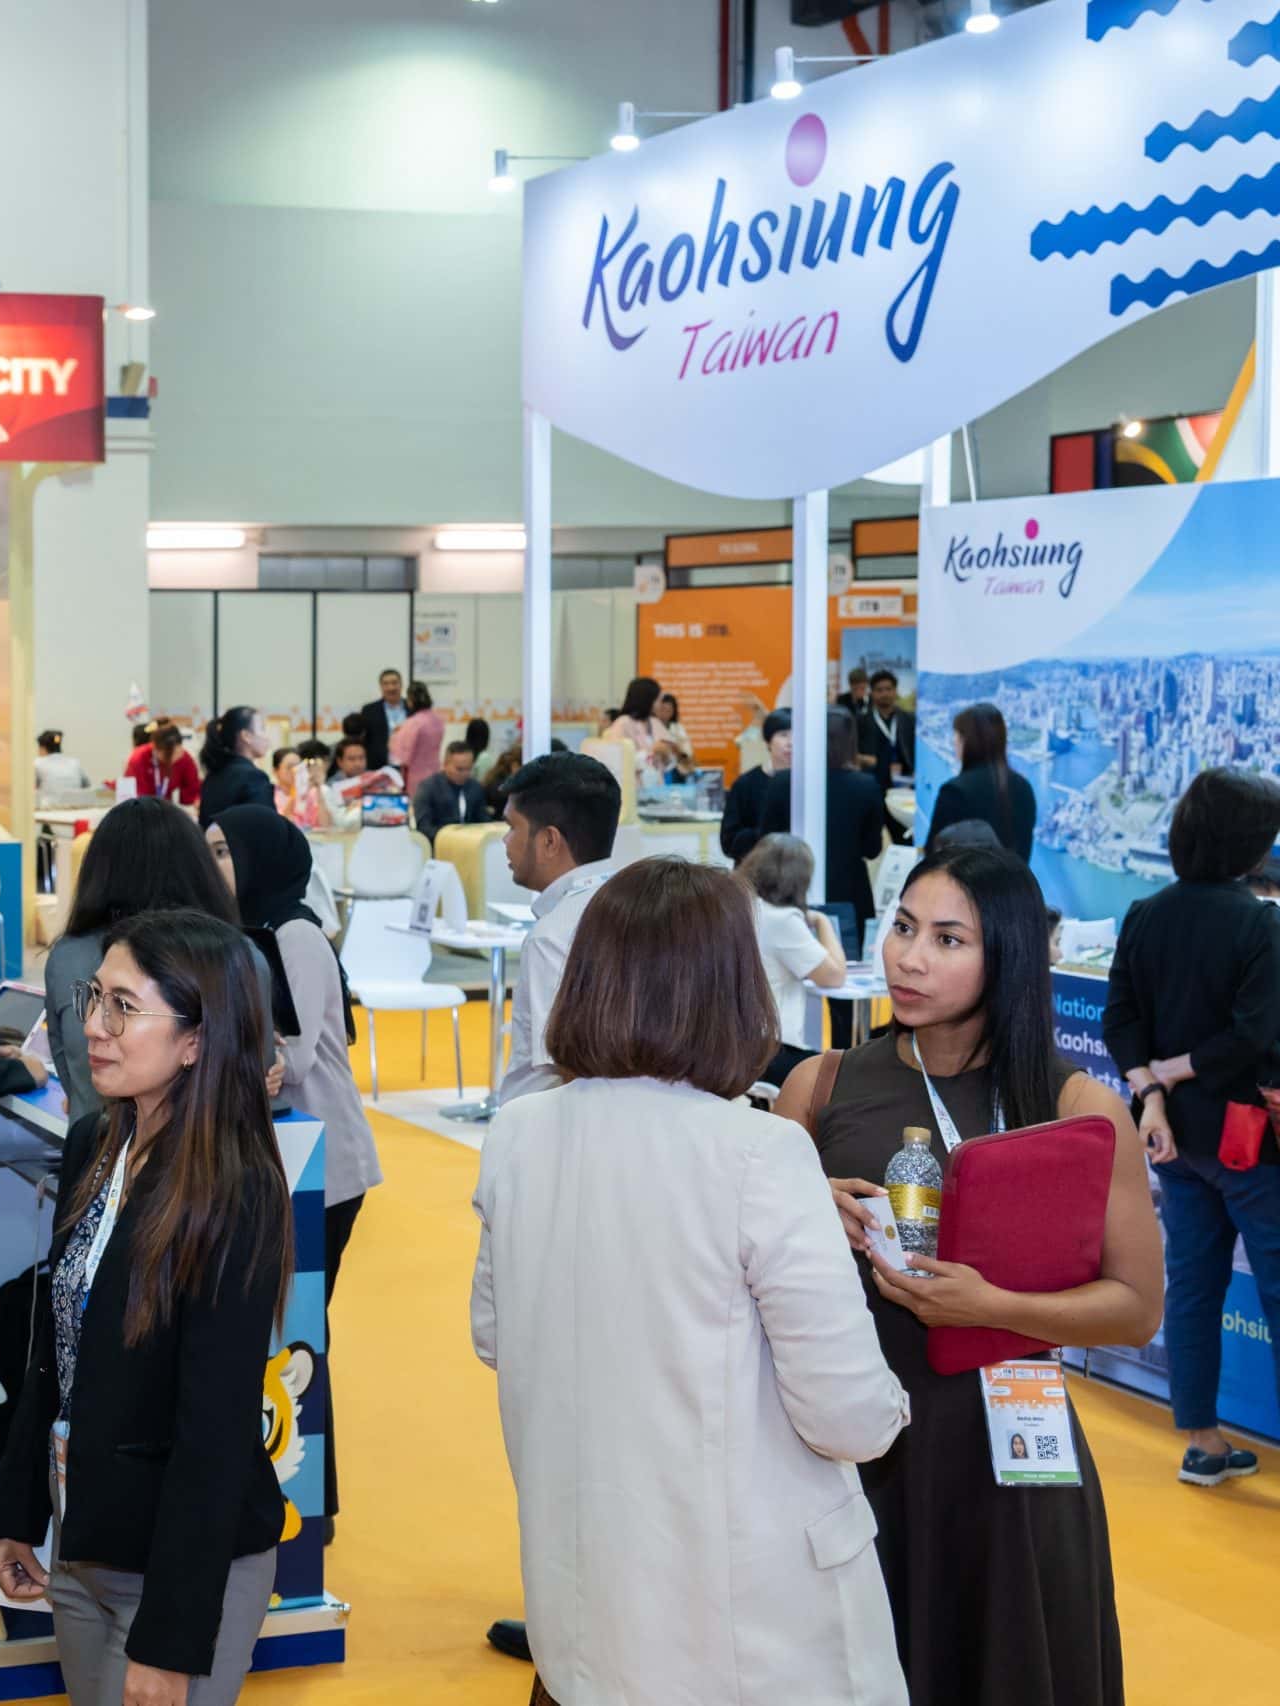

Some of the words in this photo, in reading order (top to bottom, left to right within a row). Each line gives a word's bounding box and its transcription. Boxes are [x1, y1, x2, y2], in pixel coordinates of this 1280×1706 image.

[582, 112, 961, 363] Kaohsiung
[677, 308, 842, 381] Taiwan
[944, 518, 1083, 599] Kaohsiung
[984, 577, 1045, 596] Taiwan
